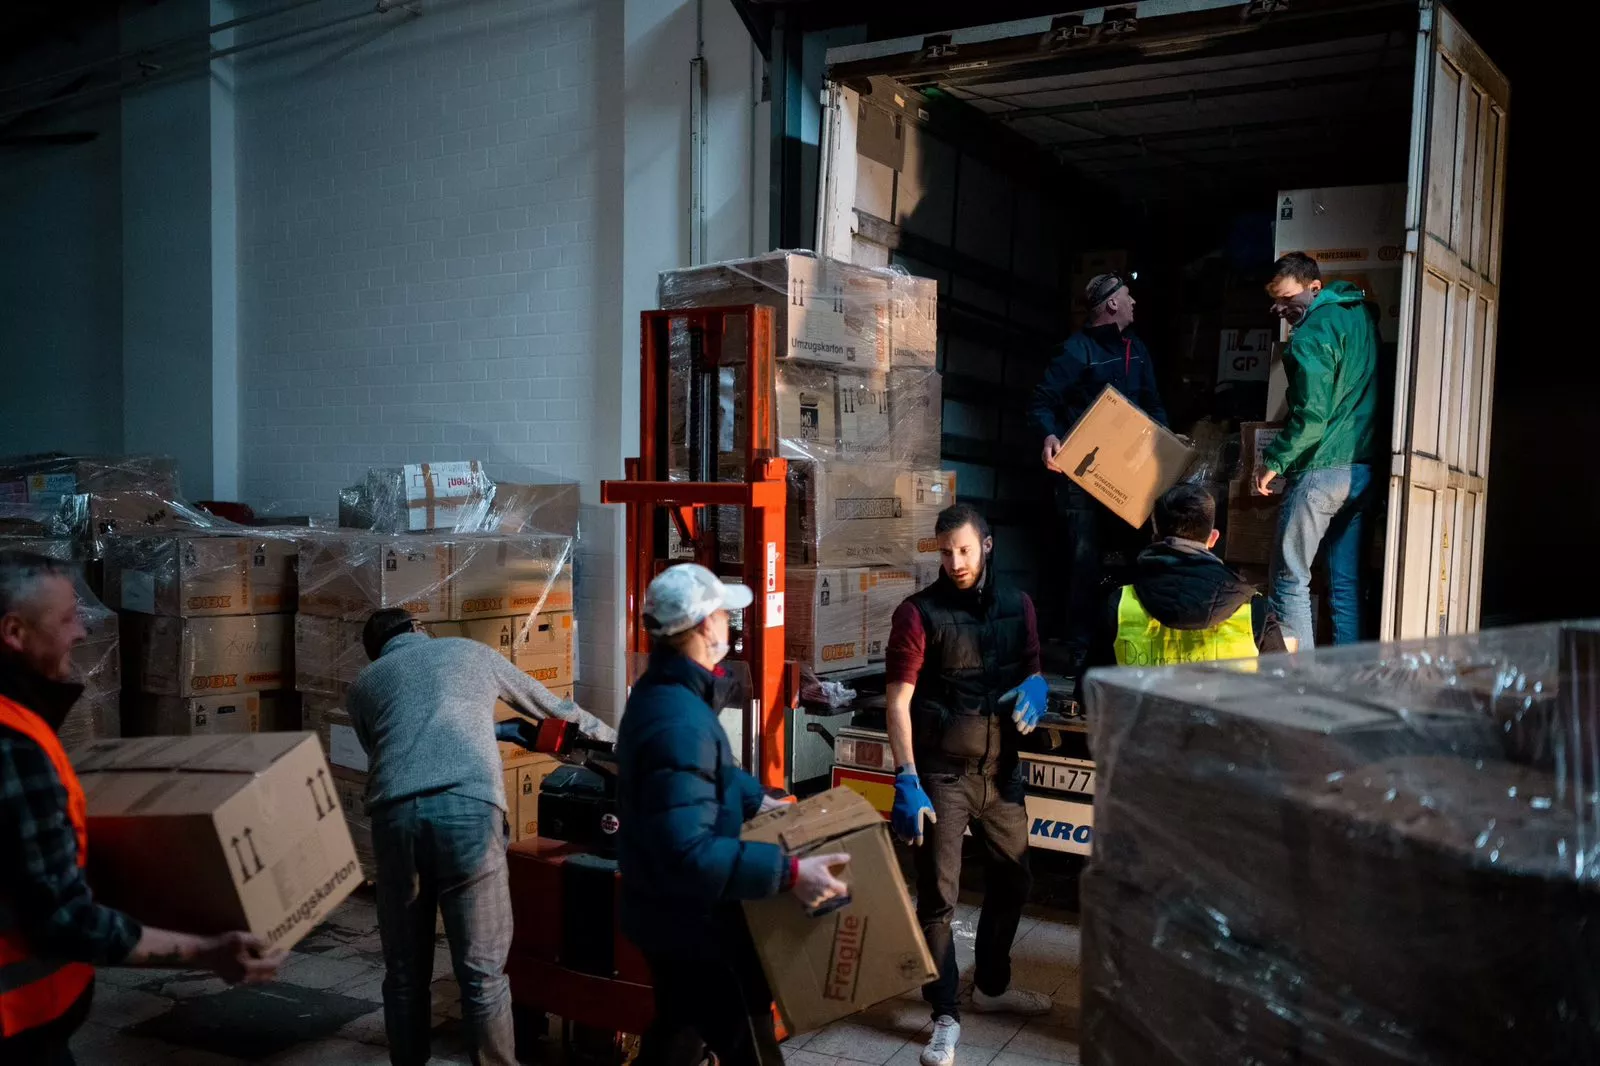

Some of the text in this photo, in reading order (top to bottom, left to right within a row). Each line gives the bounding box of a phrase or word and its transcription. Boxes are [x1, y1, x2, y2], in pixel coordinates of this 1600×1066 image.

[791, 337, 844, 355] Umzugskarton
[191, 674, 238, 690] OBI
[1032, 763, 1092, 792] WI 77
[827, 915, 861, 1002] Fragile
